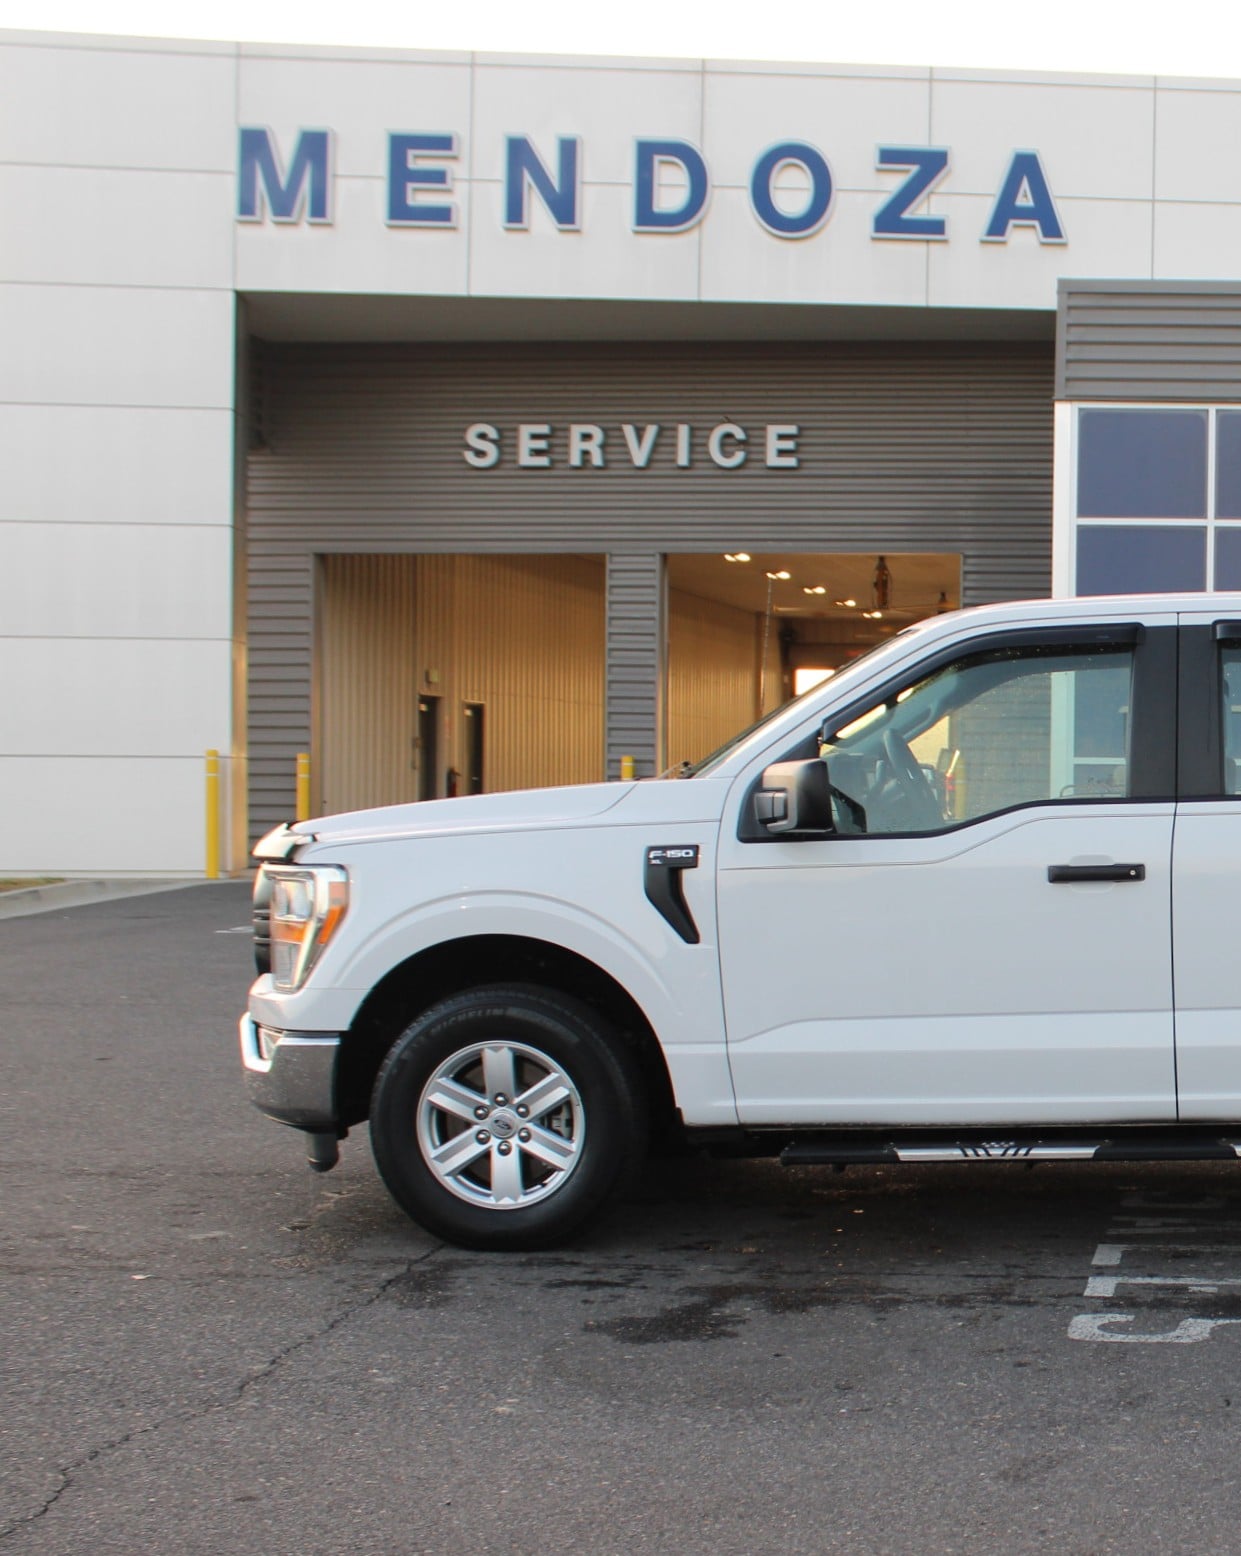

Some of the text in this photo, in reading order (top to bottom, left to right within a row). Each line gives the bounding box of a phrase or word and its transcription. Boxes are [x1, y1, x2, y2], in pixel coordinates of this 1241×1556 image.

[236, 124, 1068, 246] MENDOZA
[462, 422, 801, 470] SERVICE
[648, 849, 694, 859] F-150
[430, 1007, 505, 1034] MICHELIN
